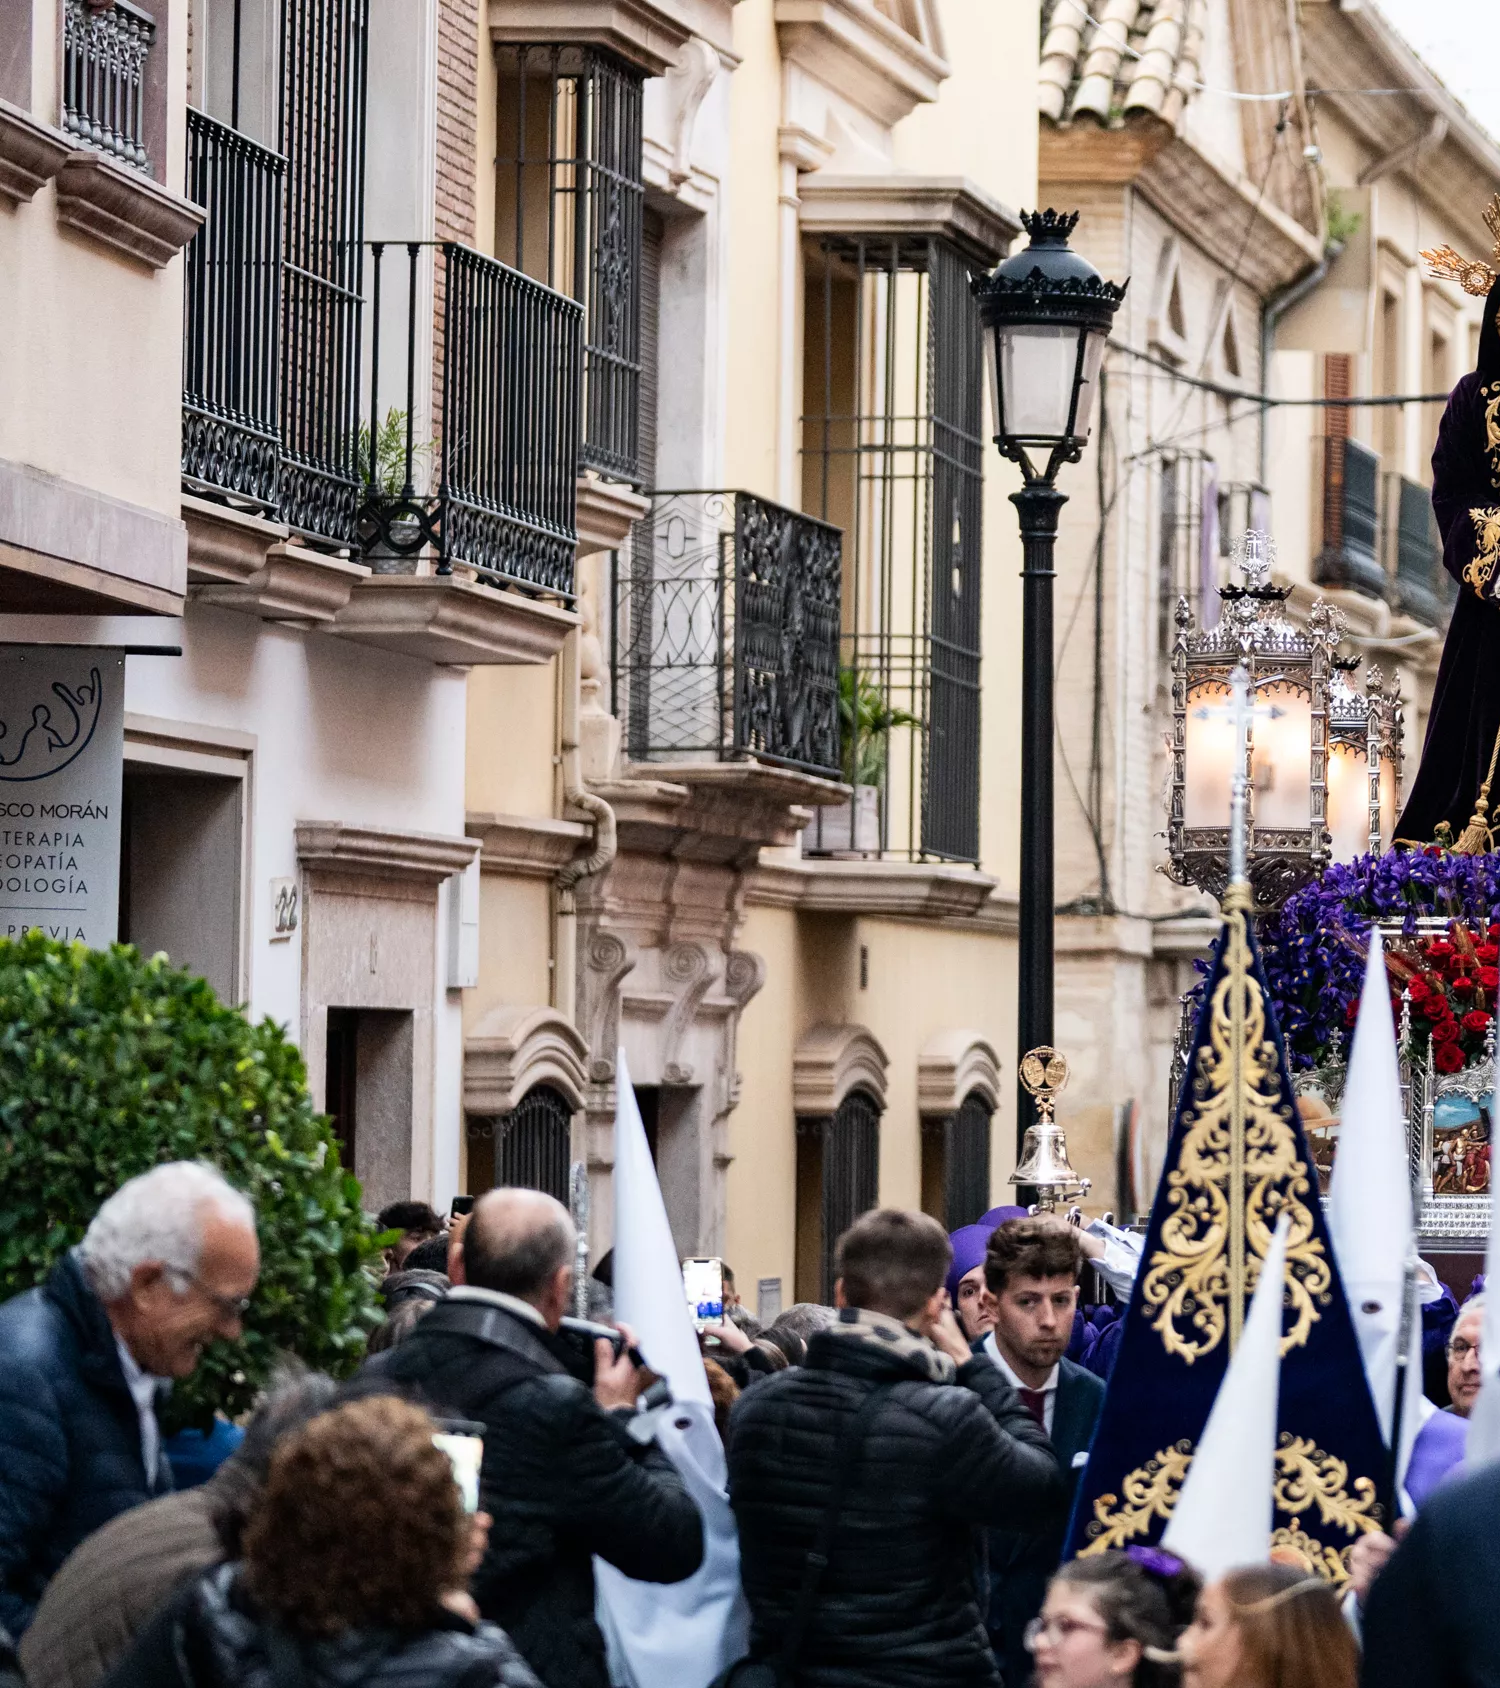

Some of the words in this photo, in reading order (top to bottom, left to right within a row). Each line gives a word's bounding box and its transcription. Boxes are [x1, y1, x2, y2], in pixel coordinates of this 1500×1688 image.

[40, 799, 108, 820] MORÁN
[3, 830, 85, 847] TERAPIA
[0, 852, 78, 870] OPATÍA
[0, 875, 88, 894] OLOGÍA
[8, 924, 86, 941] PRVIA
